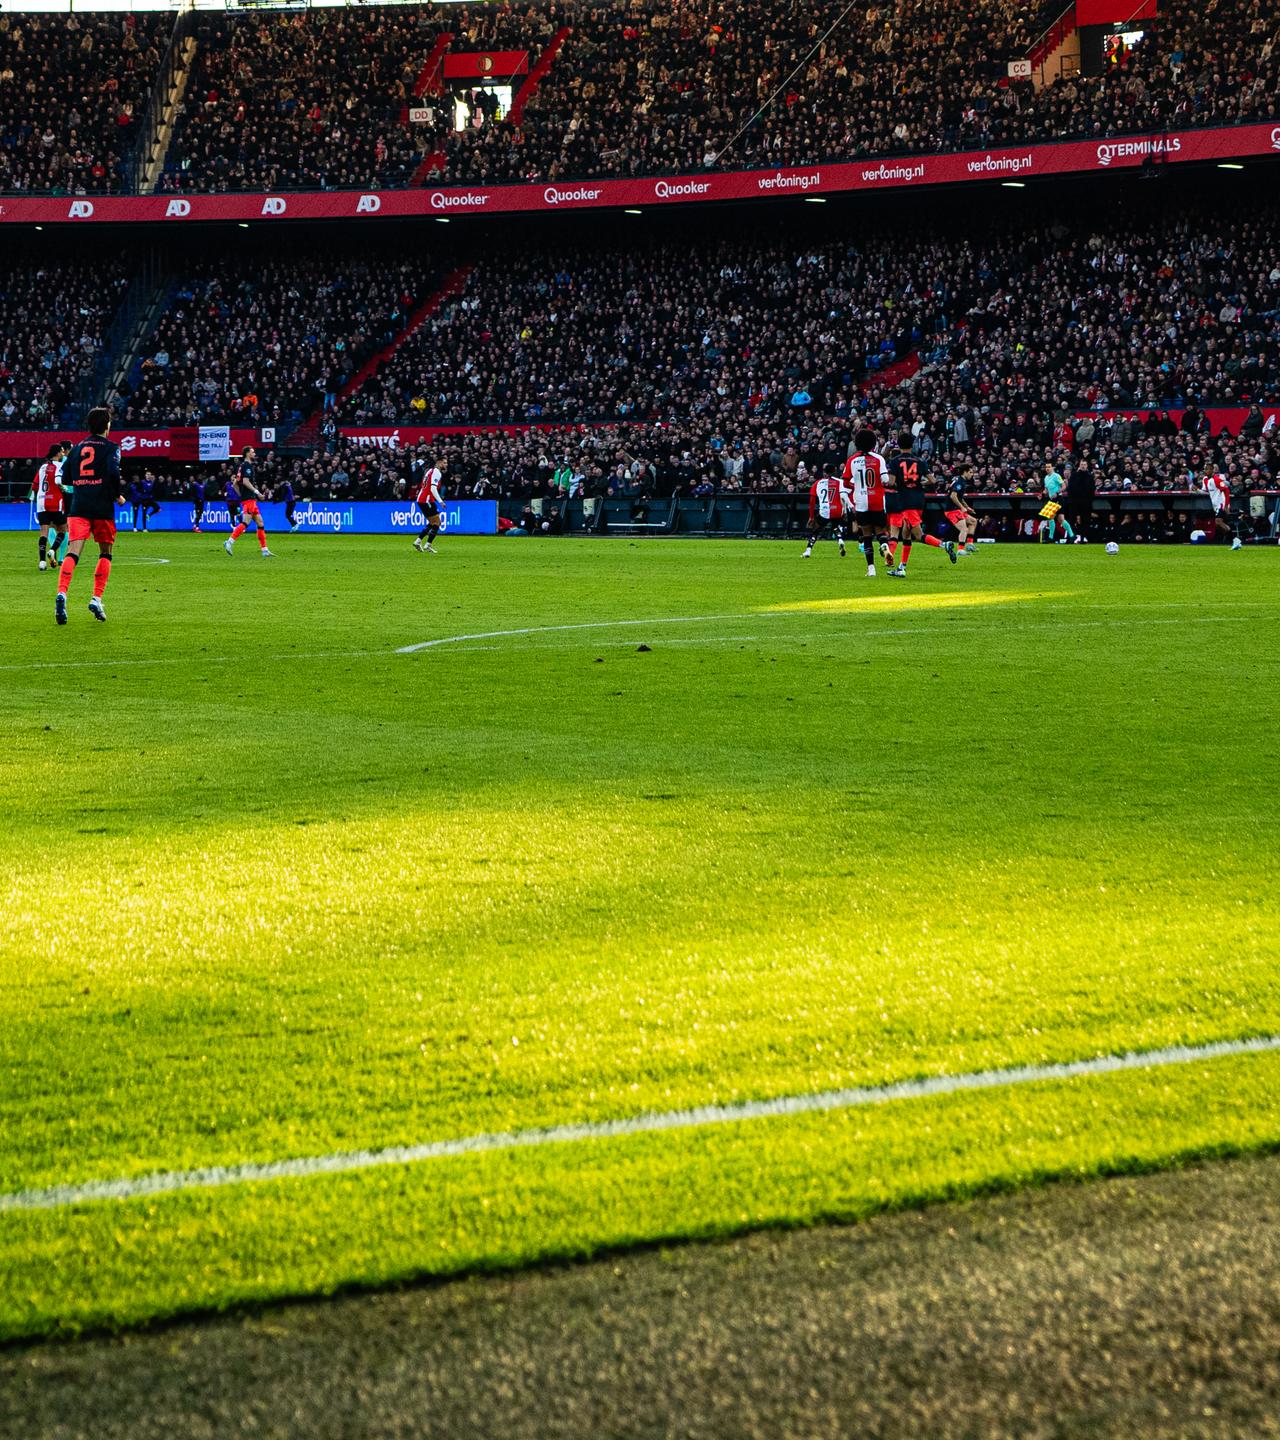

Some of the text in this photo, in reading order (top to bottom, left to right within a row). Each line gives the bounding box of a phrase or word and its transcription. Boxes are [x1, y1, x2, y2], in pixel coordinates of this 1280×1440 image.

[1013, 63, 1026, 73] CC
[414, 111, 428, 120] DD
[967, 154, 1032, 172] verloning.nl
[758, 172, 820, 189] verloning.nl
[862, 164, 924, 181] verloning.nl
[544, 188, 601, 204] Quooker
[655, 181, 709, 198] Quooker
[165, 199, 191, 217] AD
[261, 197, 287, 215] AD
[356, 195, 381, 212] AD
[431, 192, 488, 208] Quooker
[68, 200, 94, 218] AD
[140, 439, 162, 448] Port
[264, 431, 272, 440] D
[80, 446, 95, 477] 2
[857, 468, 875, 488] 10
[900, 461, 919, 481] 14
[42, 475, 49, 492] 6
[820, 488, 836, 504] 27
